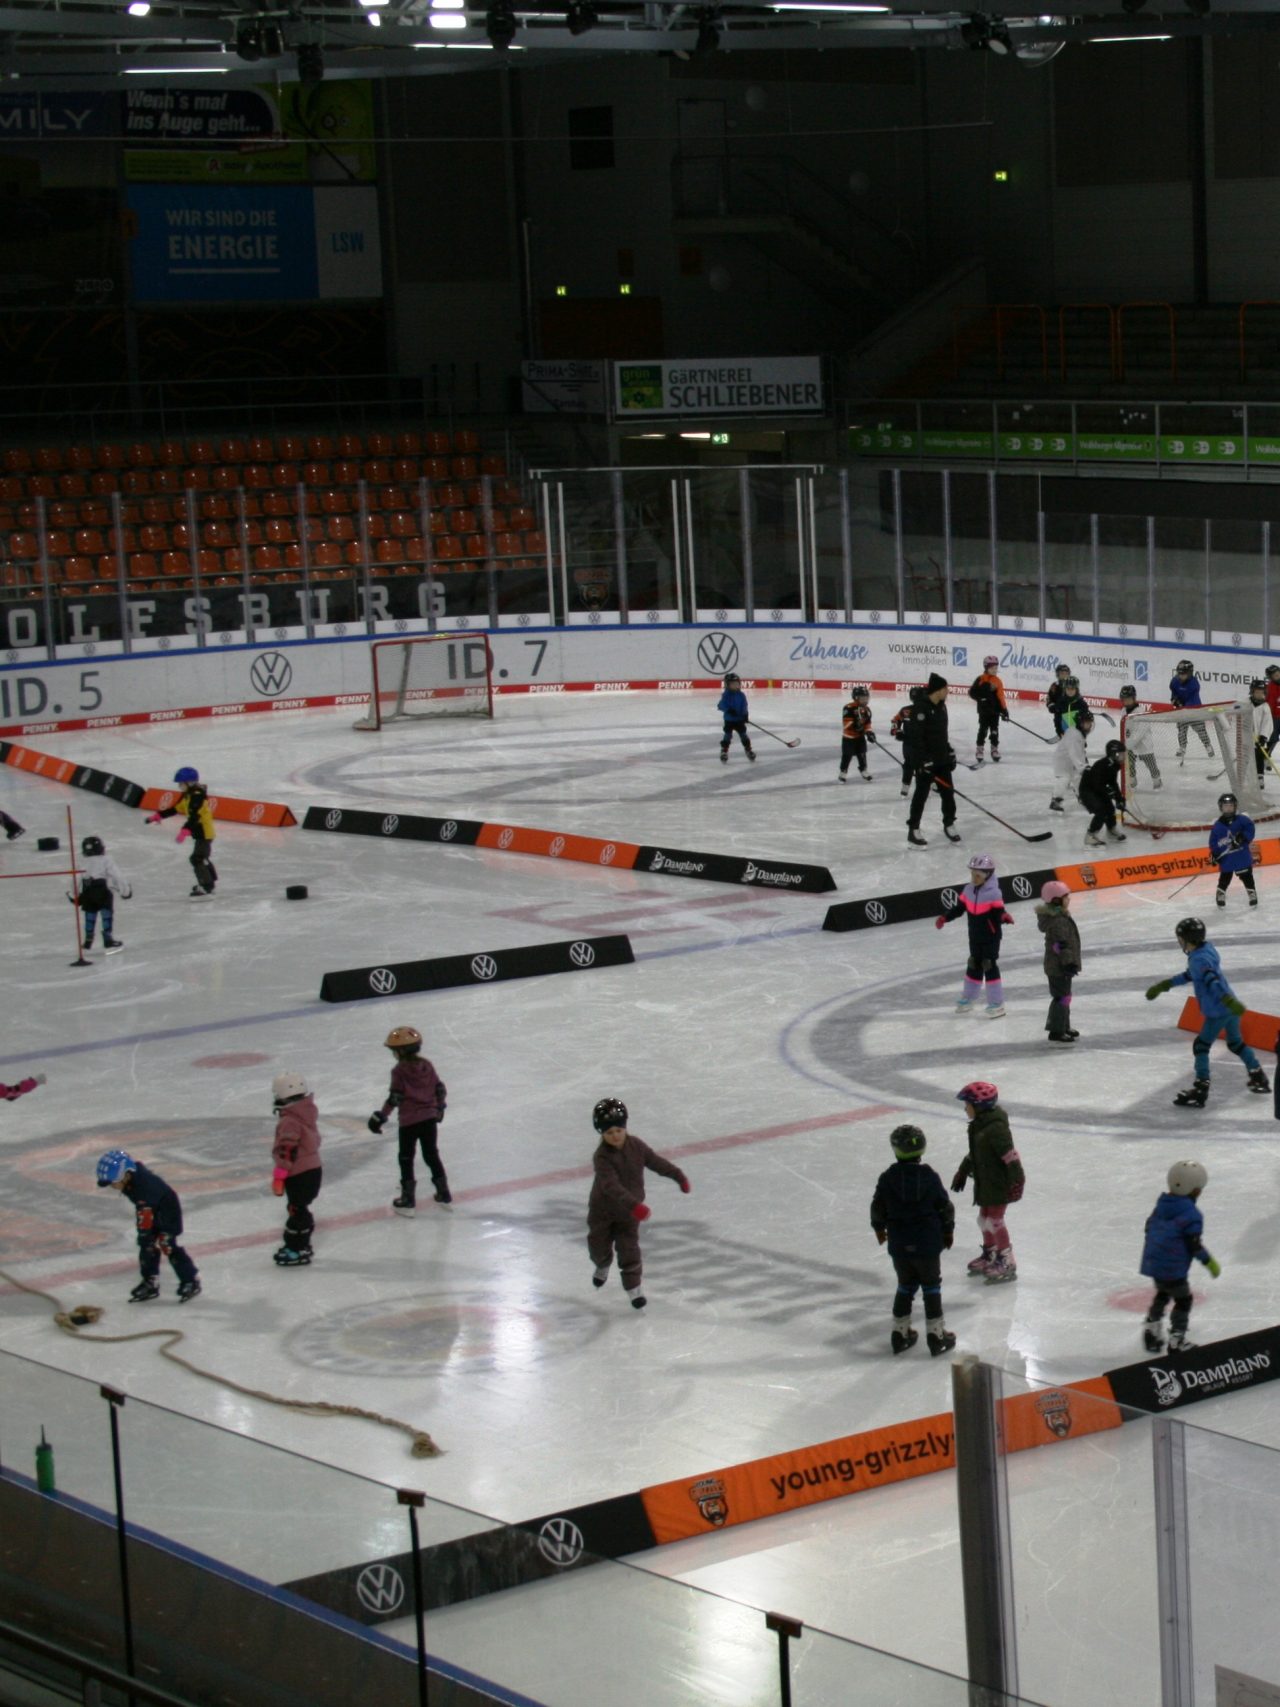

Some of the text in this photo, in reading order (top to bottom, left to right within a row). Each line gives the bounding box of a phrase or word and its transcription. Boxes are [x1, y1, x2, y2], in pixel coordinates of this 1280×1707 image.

[194, 91, 228, 111] mal
[127, 110, 154, 131] ins
[159, 111, 205, 134] Auge
[165, 209, 277, 227] WIR SIND DIE
[168, 234, 280, 260] ENERGIE
[331, 231, 366, 253] LSW
[669, 383, 818, 408] SCHLIEBENER
[447, 640, 548, 680] ID. 7
[790, 636, 869, 662] Zuhause
[888, 644, 947, 655] VOLKSWAGEN
[902, 654, 947, 667] Immobilien
[1077, 655, 1129, 669] VOLKSWAGEN
[2, 671, 102, 718] ID. 5
[770, 1430, 955, 1499] young-grizzly
